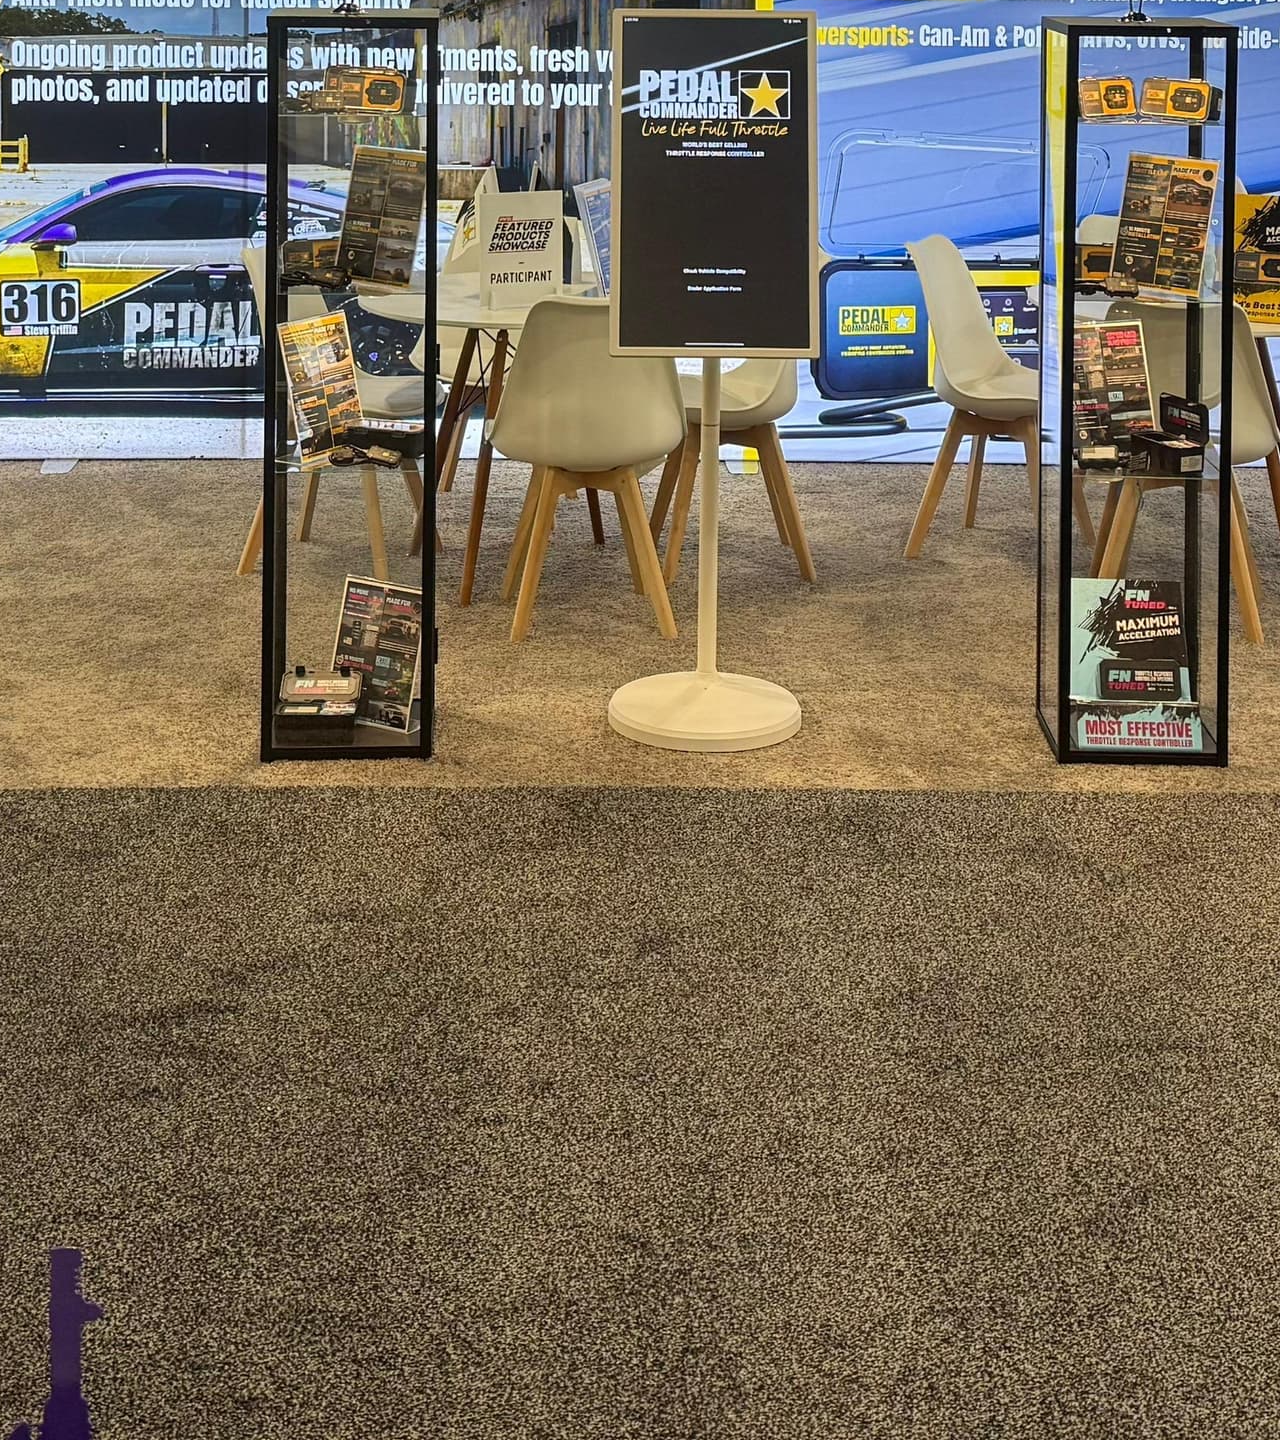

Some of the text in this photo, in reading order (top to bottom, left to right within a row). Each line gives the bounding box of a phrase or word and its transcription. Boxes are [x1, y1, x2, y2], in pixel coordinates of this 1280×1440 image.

[919, 24, 990, 47] Can-Am
[11, 39, 117, 71] Ongoing
[11, 75, 148, 106] photos, and
[639, 70, 737, 102] PEDAL
[639, 102, 738, 119] COMMANDER
[641, 120, 789, 137] Live Life Full Throttle
[494, 220, 554, 233] FEATURED
[491, 230, 551, 242] PRODUCTS
[488, 239, 548, 252] SHOWCASE
[490, 270, 553, 285] PARTICIPANT
[3, 283, 77, 324] 316
[841, 308, 889, 324] PEDAL
[24, 324, 79, 336] Steve Griffin
[124, 301, 260, 347] PEDAL
[841, 323, 889, 333] COMMANDER
[123, 345, 258, 370] COMMANDER
[1125, 589, 1150, 602] FN
[1124, 601, 1166, 610] TUNED
[1116, 614, 1180, 632] MAXIMUM
[1119, 627, 1181, 641] ACCELERATION
[1108, 670, 1132, 682] FN
[1108, 682, 1146, 691] TUNED
[1085, 720, 1193, 738] MOST EFFECTIVE
[1086, 736, 1193, 748] THROTTLE RESPONSE CONTROLLER
